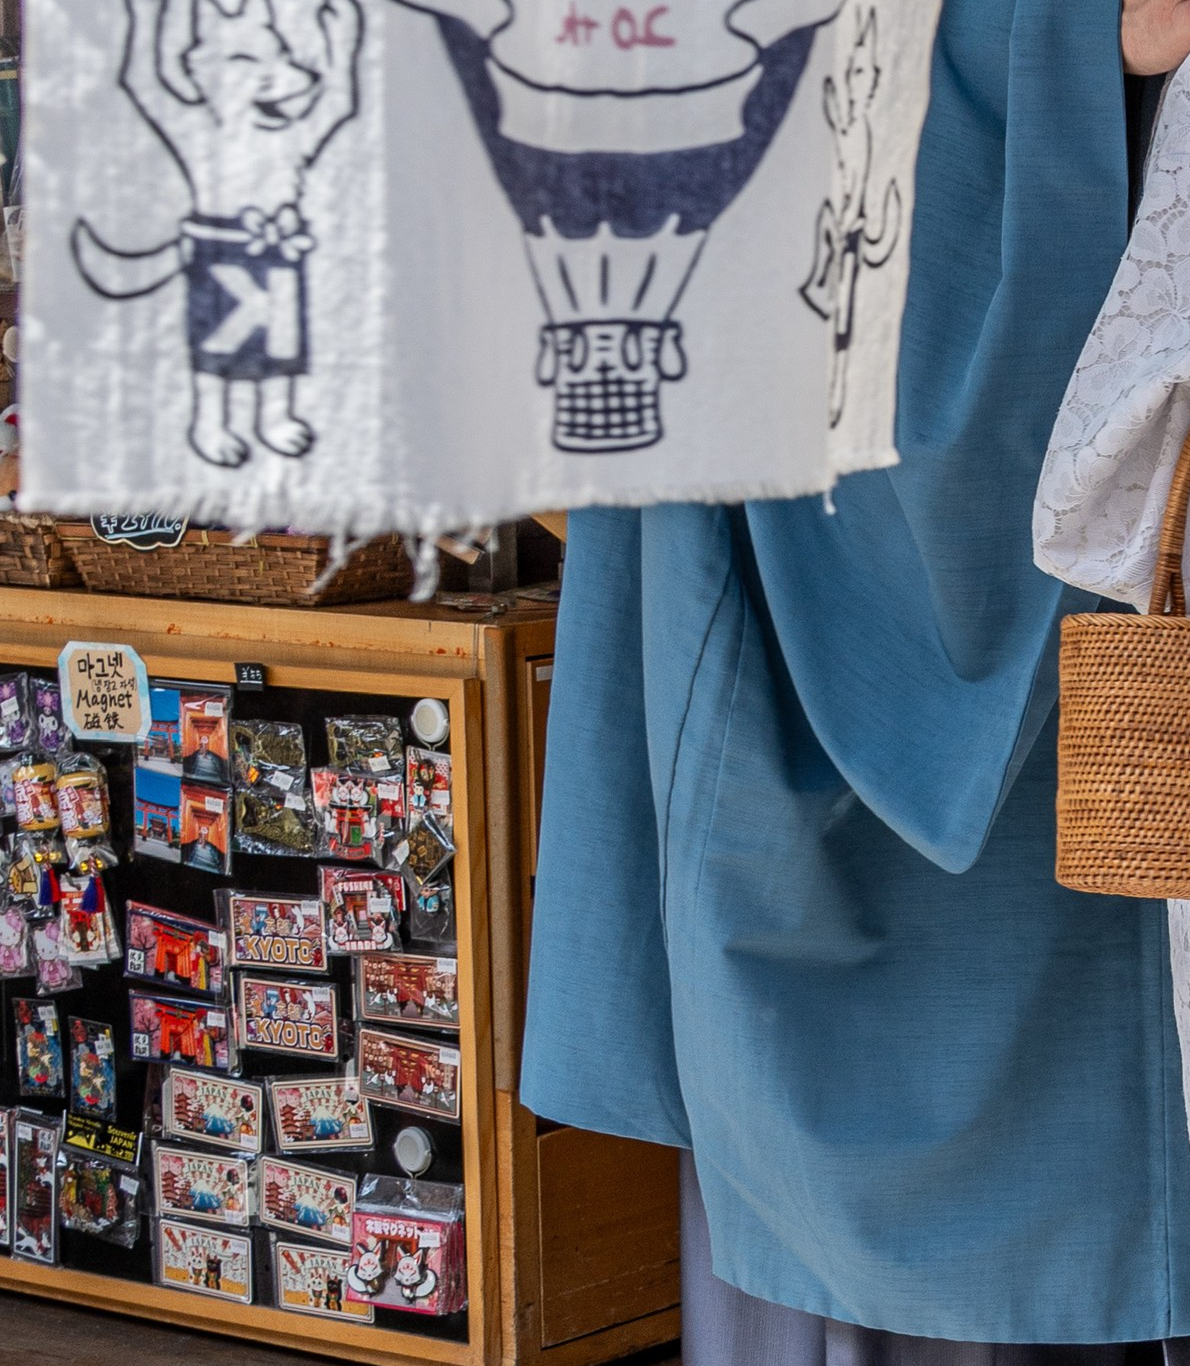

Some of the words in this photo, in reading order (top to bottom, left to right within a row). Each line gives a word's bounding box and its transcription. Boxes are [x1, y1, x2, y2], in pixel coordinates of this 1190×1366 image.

[77, 651, 124, 679] 마그넷
[76, 689, 133, 714] Magnet
[243, 934, 315, 965] KYOTO
[255, 1015, 324, 1051] KYOTO
[200, 1086, 228, 1099] JAPAN
[304, 1088, 332, 1101] JAPAN
[186, 1162, 214, 1174] JAPAN
[292, 1176, 321, 1189] JAPAN
[190, 1237, 218, 1249] JAPAN
[309, 1258, 338, 1271] JAPAN
